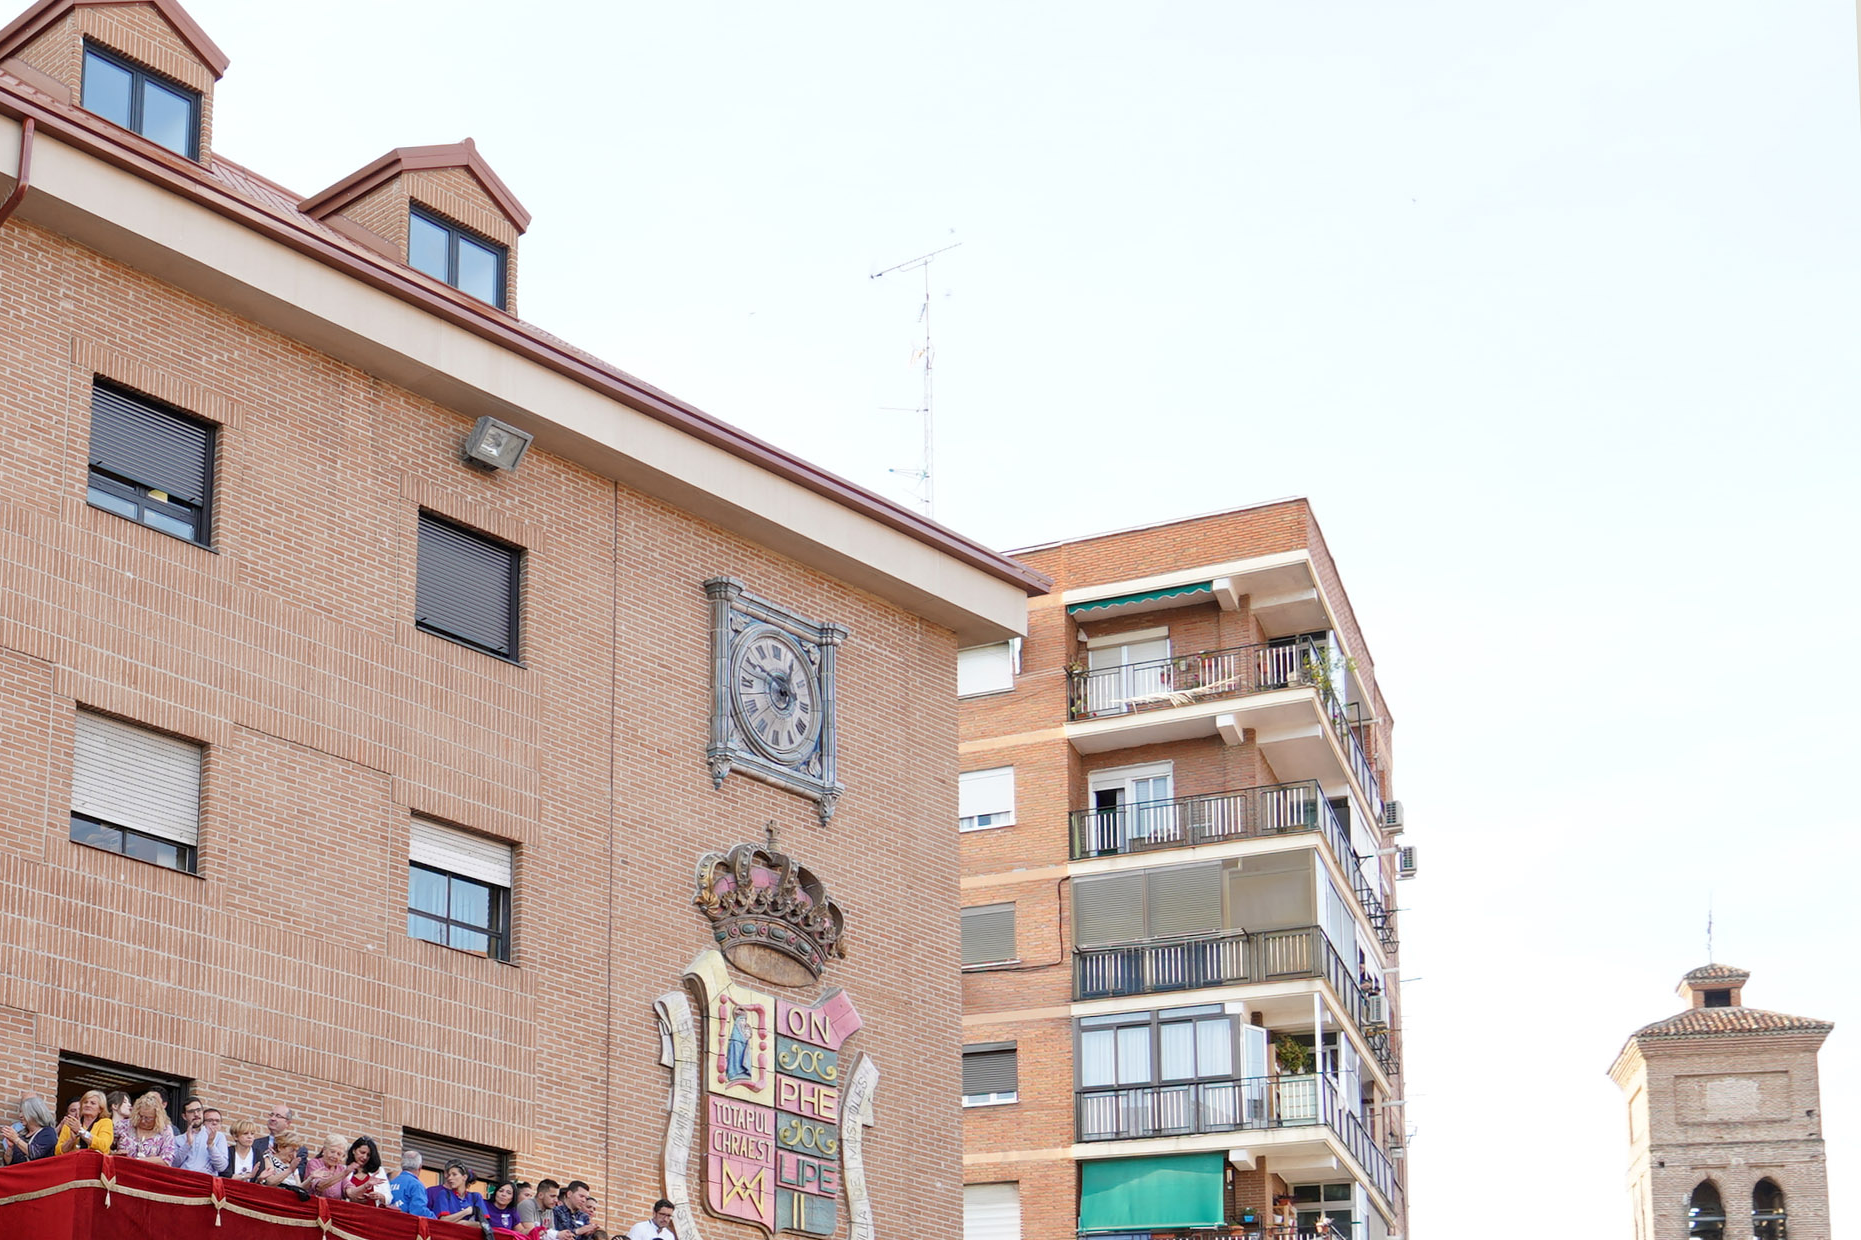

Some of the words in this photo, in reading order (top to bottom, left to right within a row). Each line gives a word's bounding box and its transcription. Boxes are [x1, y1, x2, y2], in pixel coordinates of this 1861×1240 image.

[788, 1007, 830, 1044] ON
[779, 1074, 837, 1121] PHE
[713, 1100, 772, 1136] TOTAPUL
[713, 1129, 773, 1164] CHRAEST
[779, 1158, 837, 1195] LIPE
